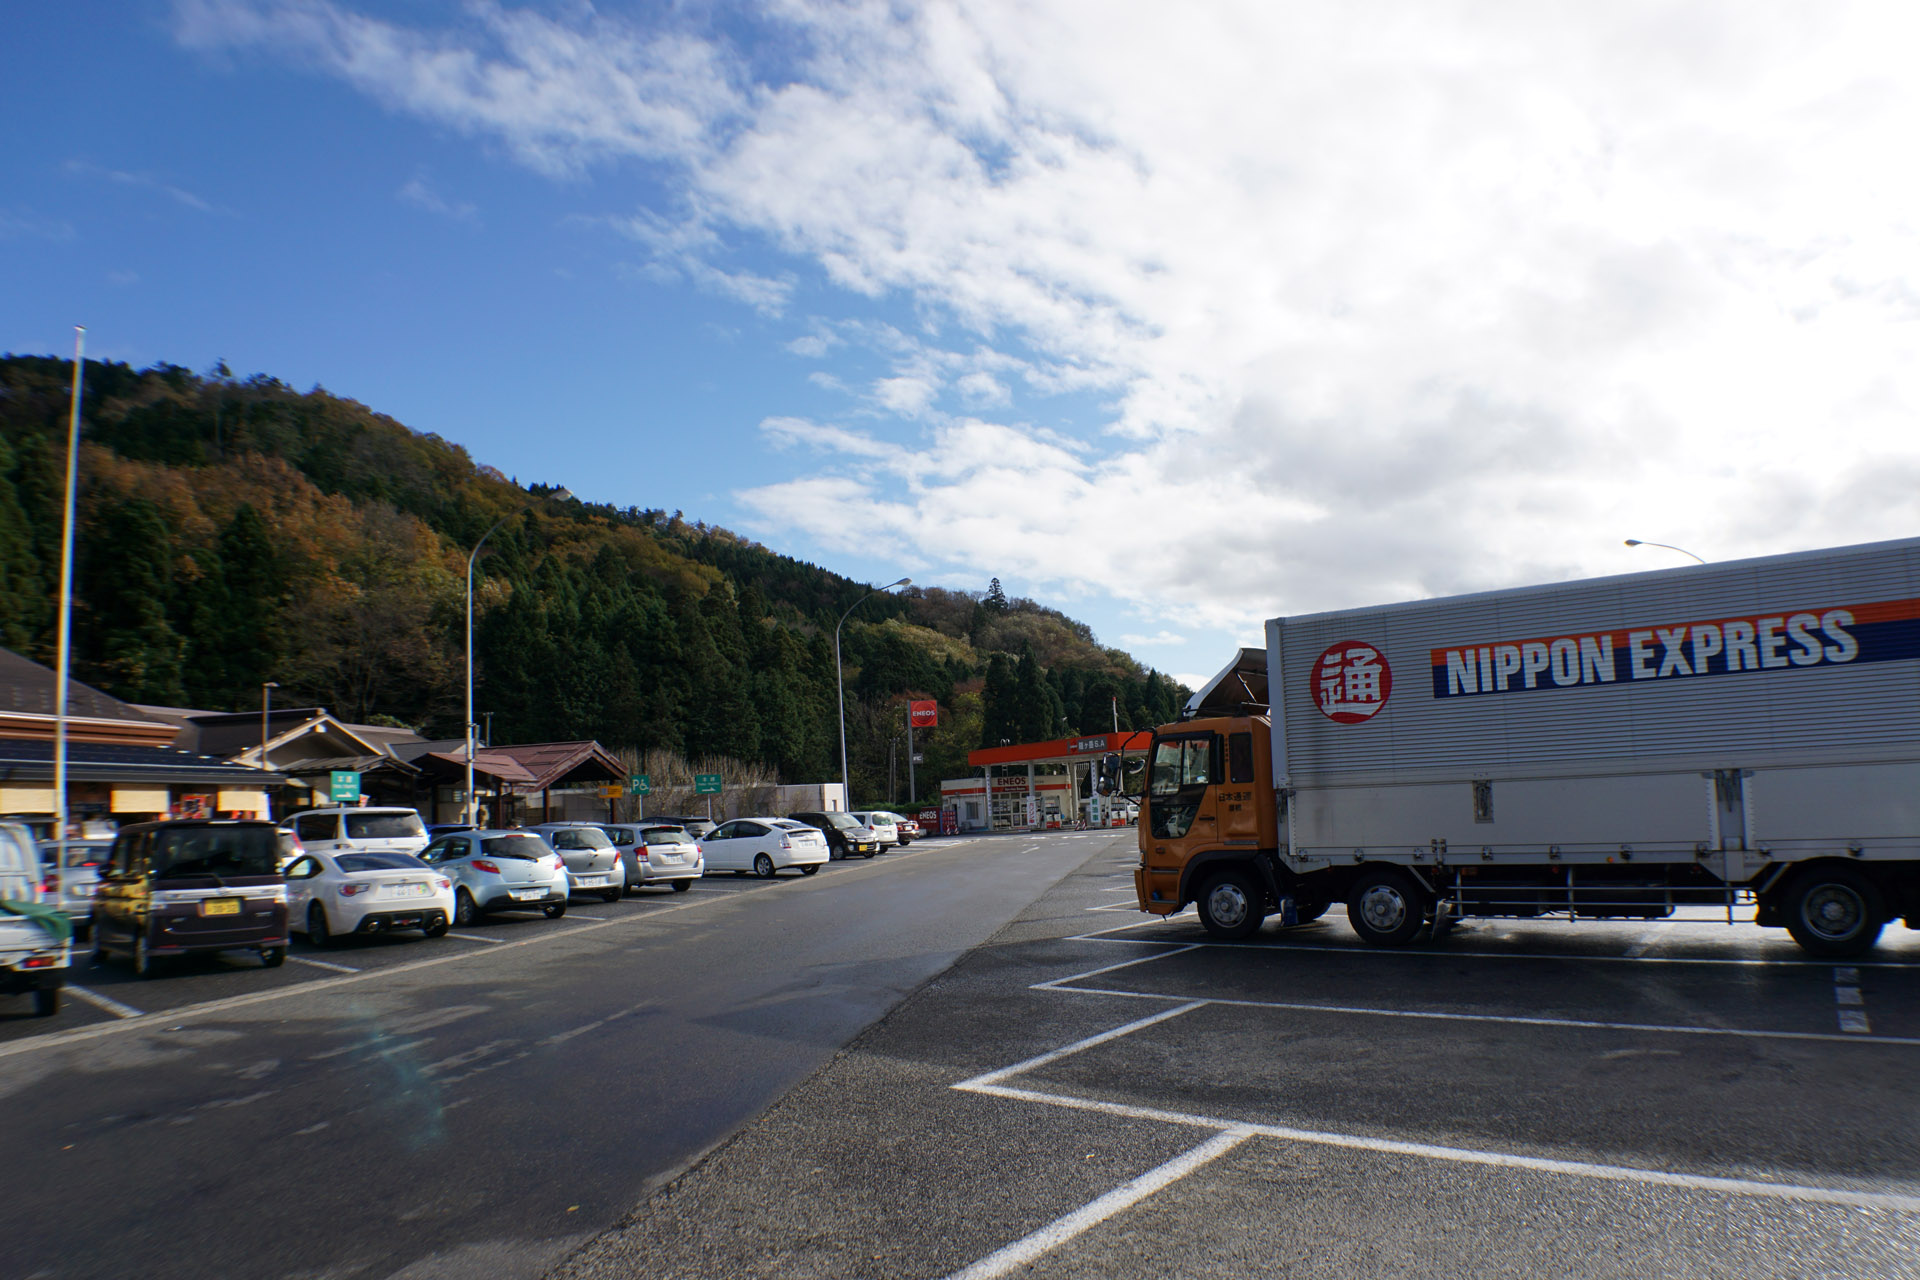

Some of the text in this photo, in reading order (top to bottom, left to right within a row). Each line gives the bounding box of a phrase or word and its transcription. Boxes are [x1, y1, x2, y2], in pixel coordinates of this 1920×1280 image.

[1447, 609, 1860, 695] NIPPON EXPRESS
[997, 777, 1026, 786] ENEOS
[920, 811, 937, 820] ENEOS
